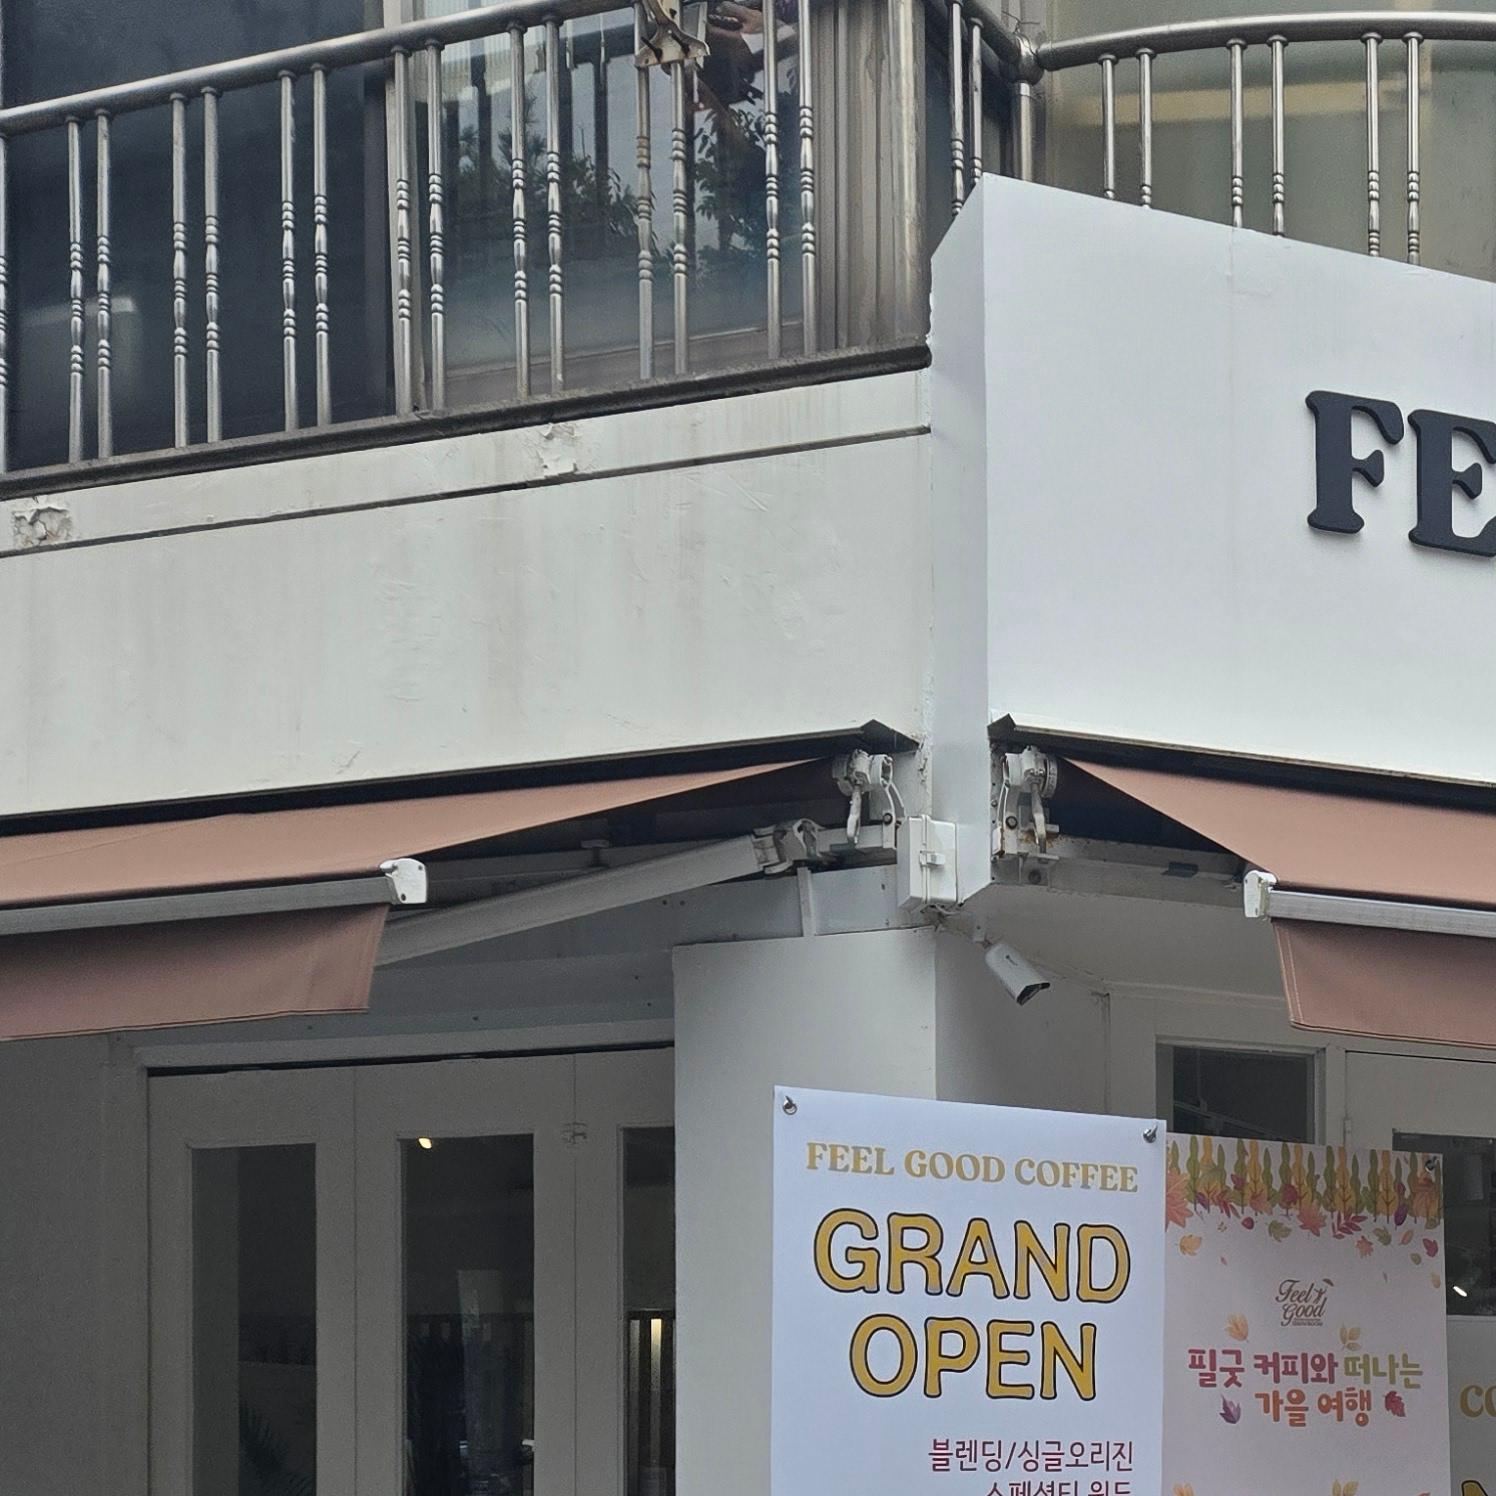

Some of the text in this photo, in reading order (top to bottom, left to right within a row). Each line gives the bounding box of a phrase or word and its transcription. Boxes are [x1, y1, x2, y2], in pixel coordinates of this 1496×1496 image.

[806, 1142, 1138, 1193] FEEL GOOD COFFEE
[813, 1207, 1131, 1304] GRAND
[1275, 1279, 1314, 1303] Feel
[1281, 1297, 1327, 1327] Good
[849, 1313, 1097, 1401] OPEN
[1188, 1348, 1423, 1390] 필굿 커피와 떠나는
[1254, 1386, 1373, 1428] 가을 여행
[928, 1438, 1133, 1472] 블렌딩/싱글오리진
